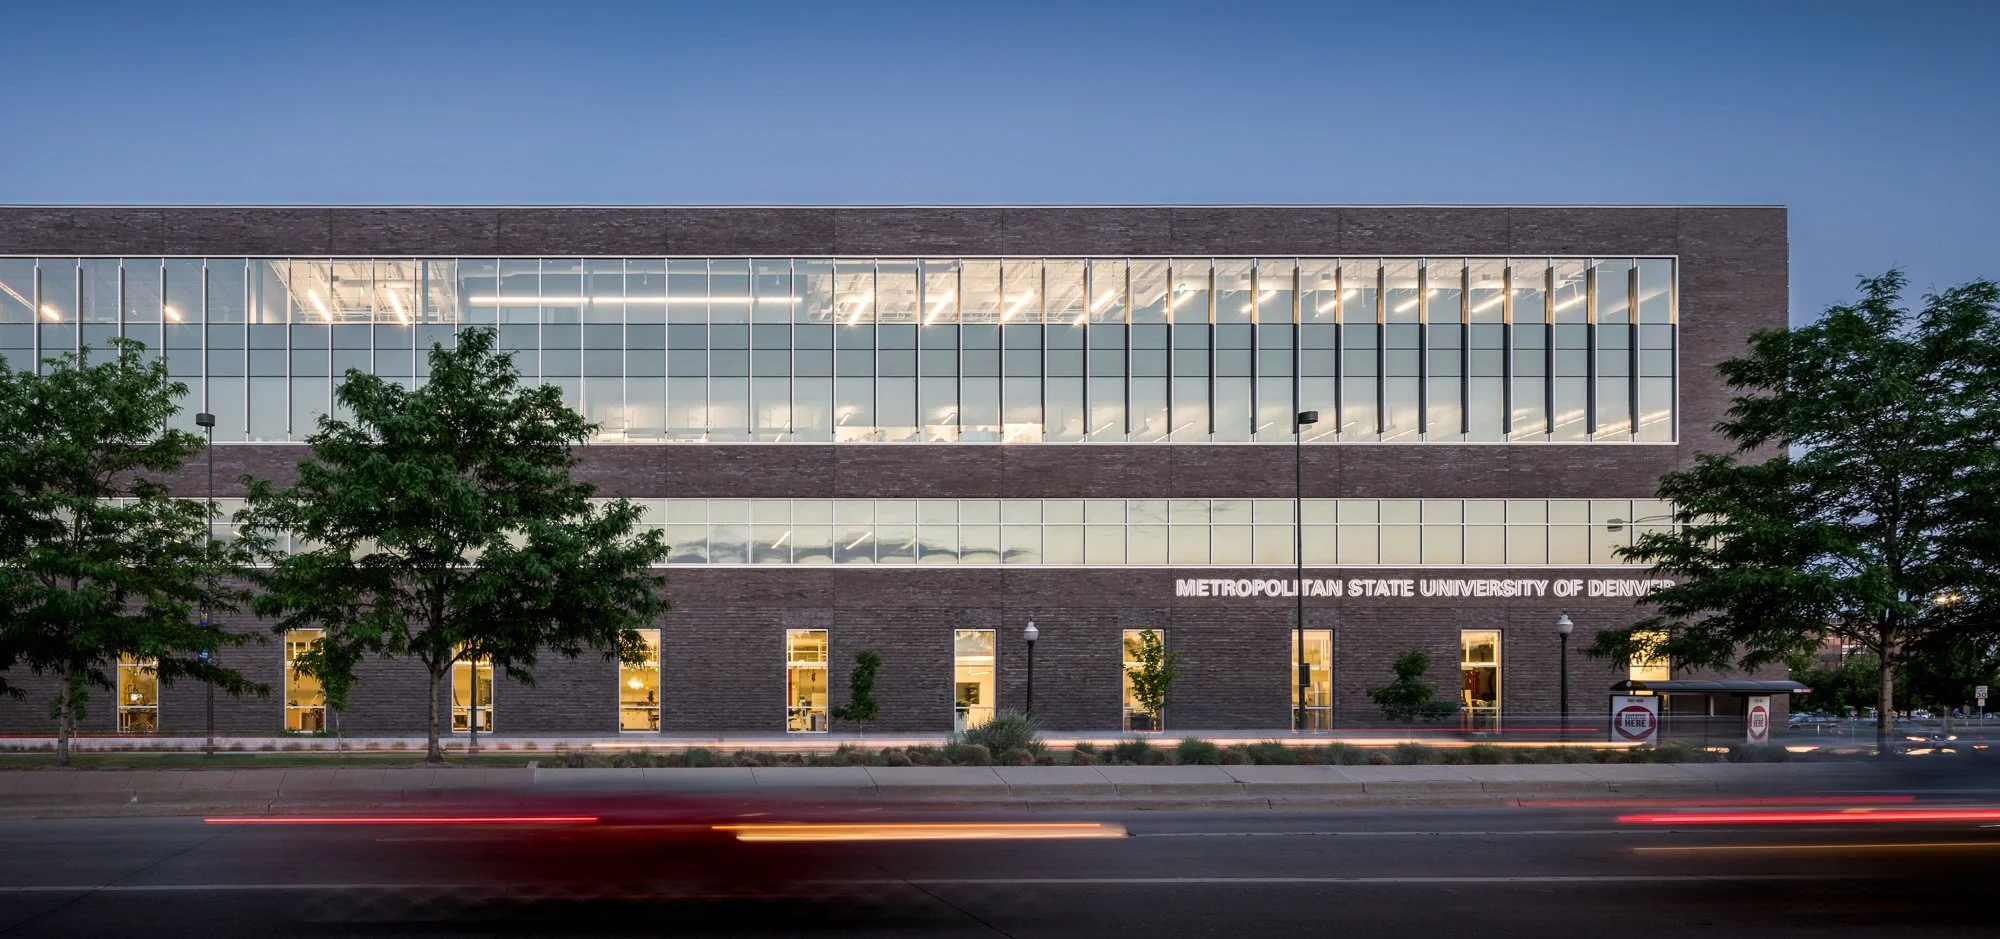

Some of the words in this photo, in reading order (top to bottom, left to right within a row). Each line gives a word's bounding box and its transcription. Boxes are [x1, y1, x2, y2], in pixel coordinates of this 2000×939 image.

[1176, 579, 1342, 597] METROPOLITAN
[1348, 579, 1414, 597] STATE
[1420, 579, 1549, 597] UNIVERSITY
[1553, 579, 1583, 597] OF
